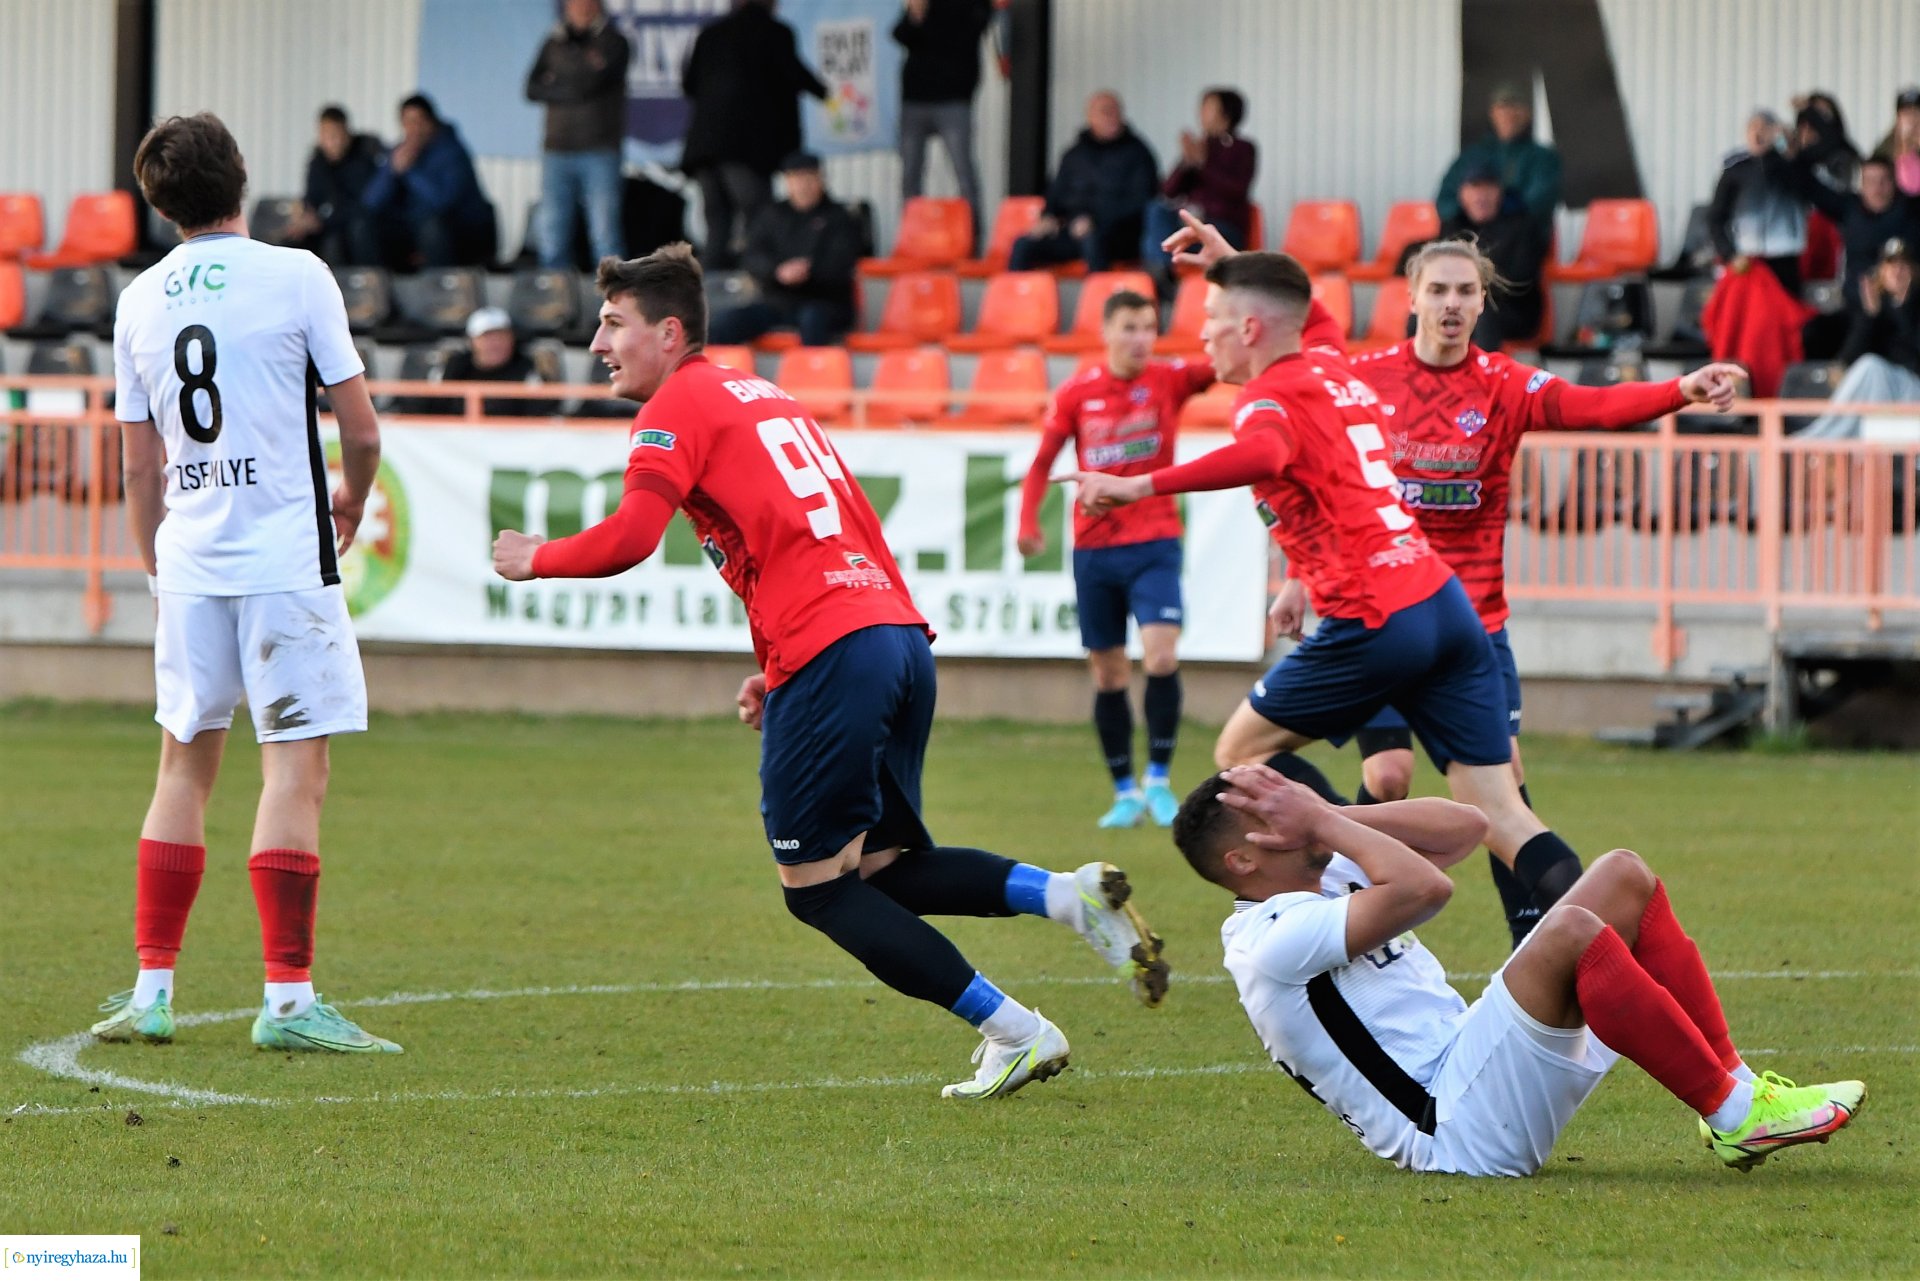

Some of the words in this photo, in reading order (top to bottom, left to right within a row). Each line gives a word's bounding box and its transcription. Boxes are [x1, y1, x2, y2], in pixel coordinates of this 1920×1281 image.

[174, 324, 222, 443] 8
[756, 417, 853, 540] 94
[1346, 423, 1416, 531] 5
[486, 583, 656, 629] Magyar
[772, 838, 801, 850] JAKO
